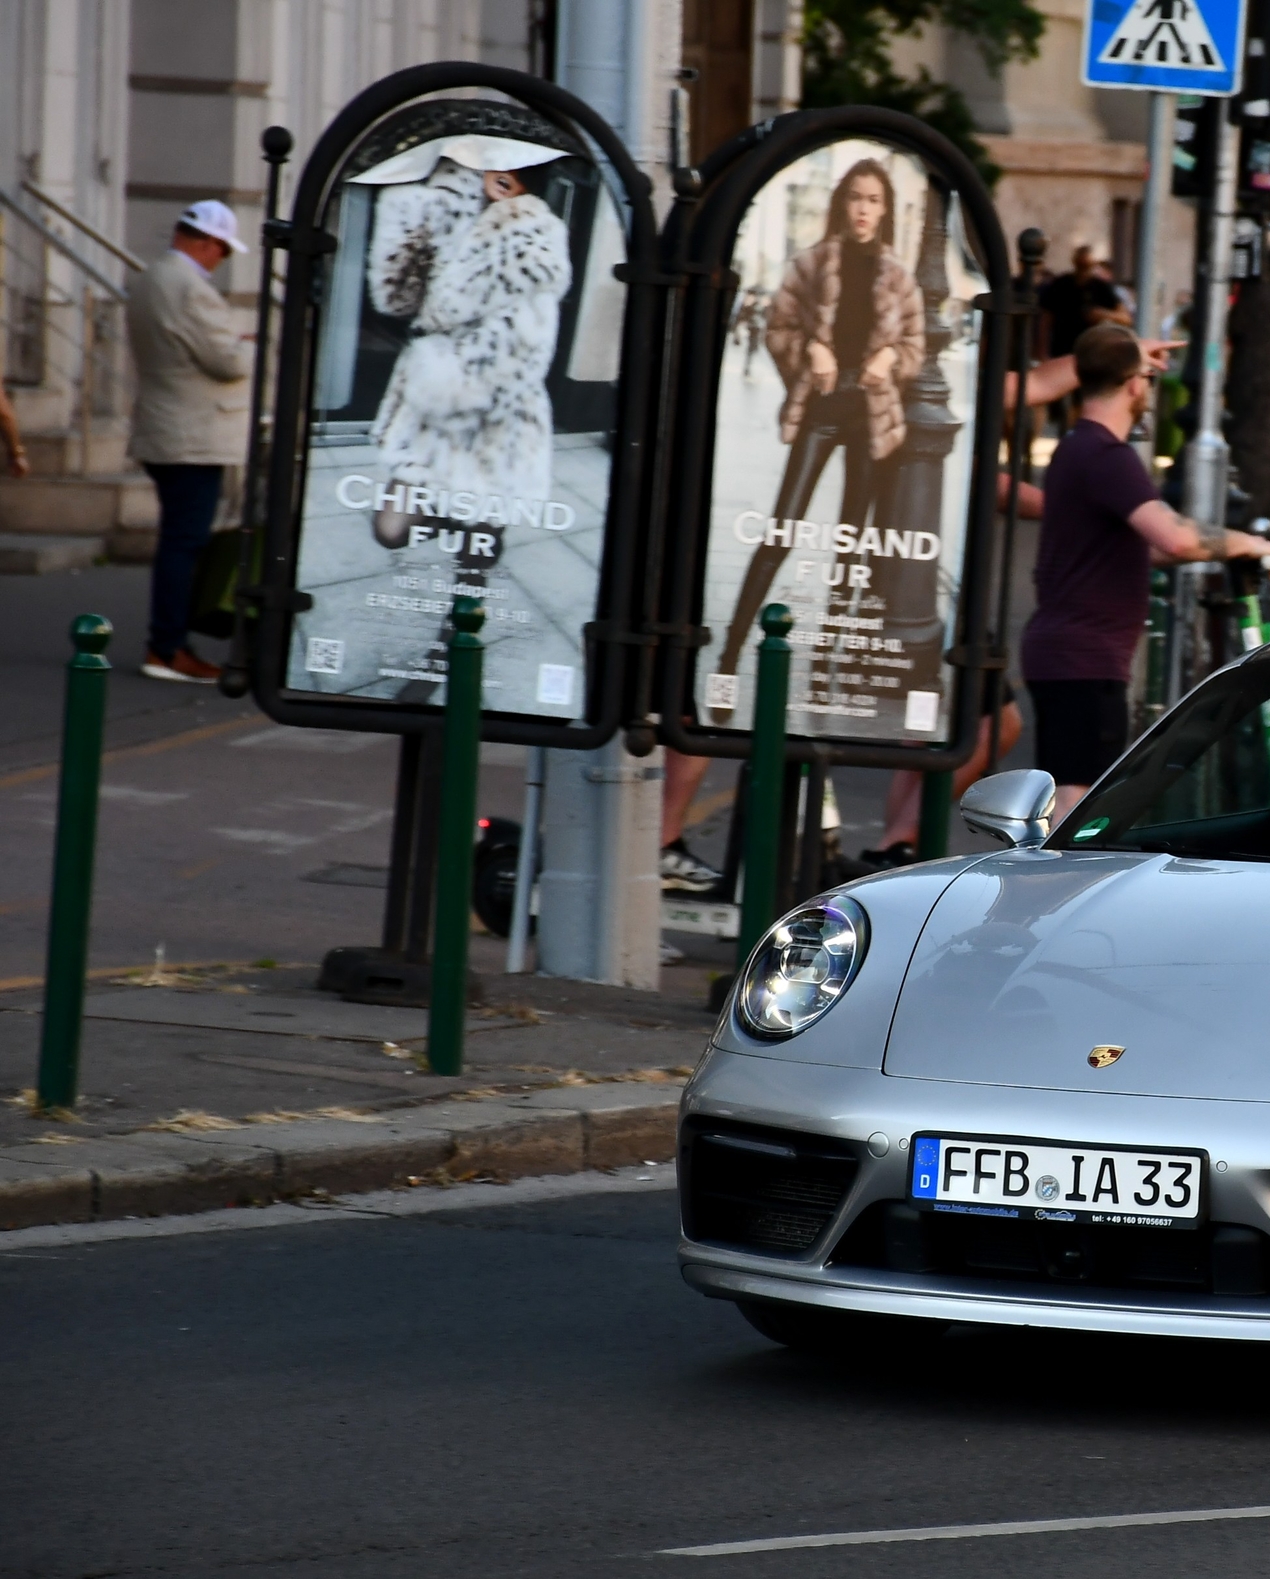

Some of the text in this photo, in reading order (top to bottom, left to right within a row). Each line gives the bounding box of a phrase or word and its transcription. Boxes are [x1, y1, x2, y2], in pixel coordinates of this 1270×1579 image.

[335, 474, 576, 531] CHRISAND
[408, 525, 496, 558] FUR
[733, 511, 942, 561] CHRISAND
[795, 560, 873, 589] FUR
[919, 1146, 1193, 1208] D FFB IA 33
[1091, 1214, 1105, 1222] tel:
[1106, 1215, 1121, 1223] +49
[1123, 1216, 1136, 1224] 160
